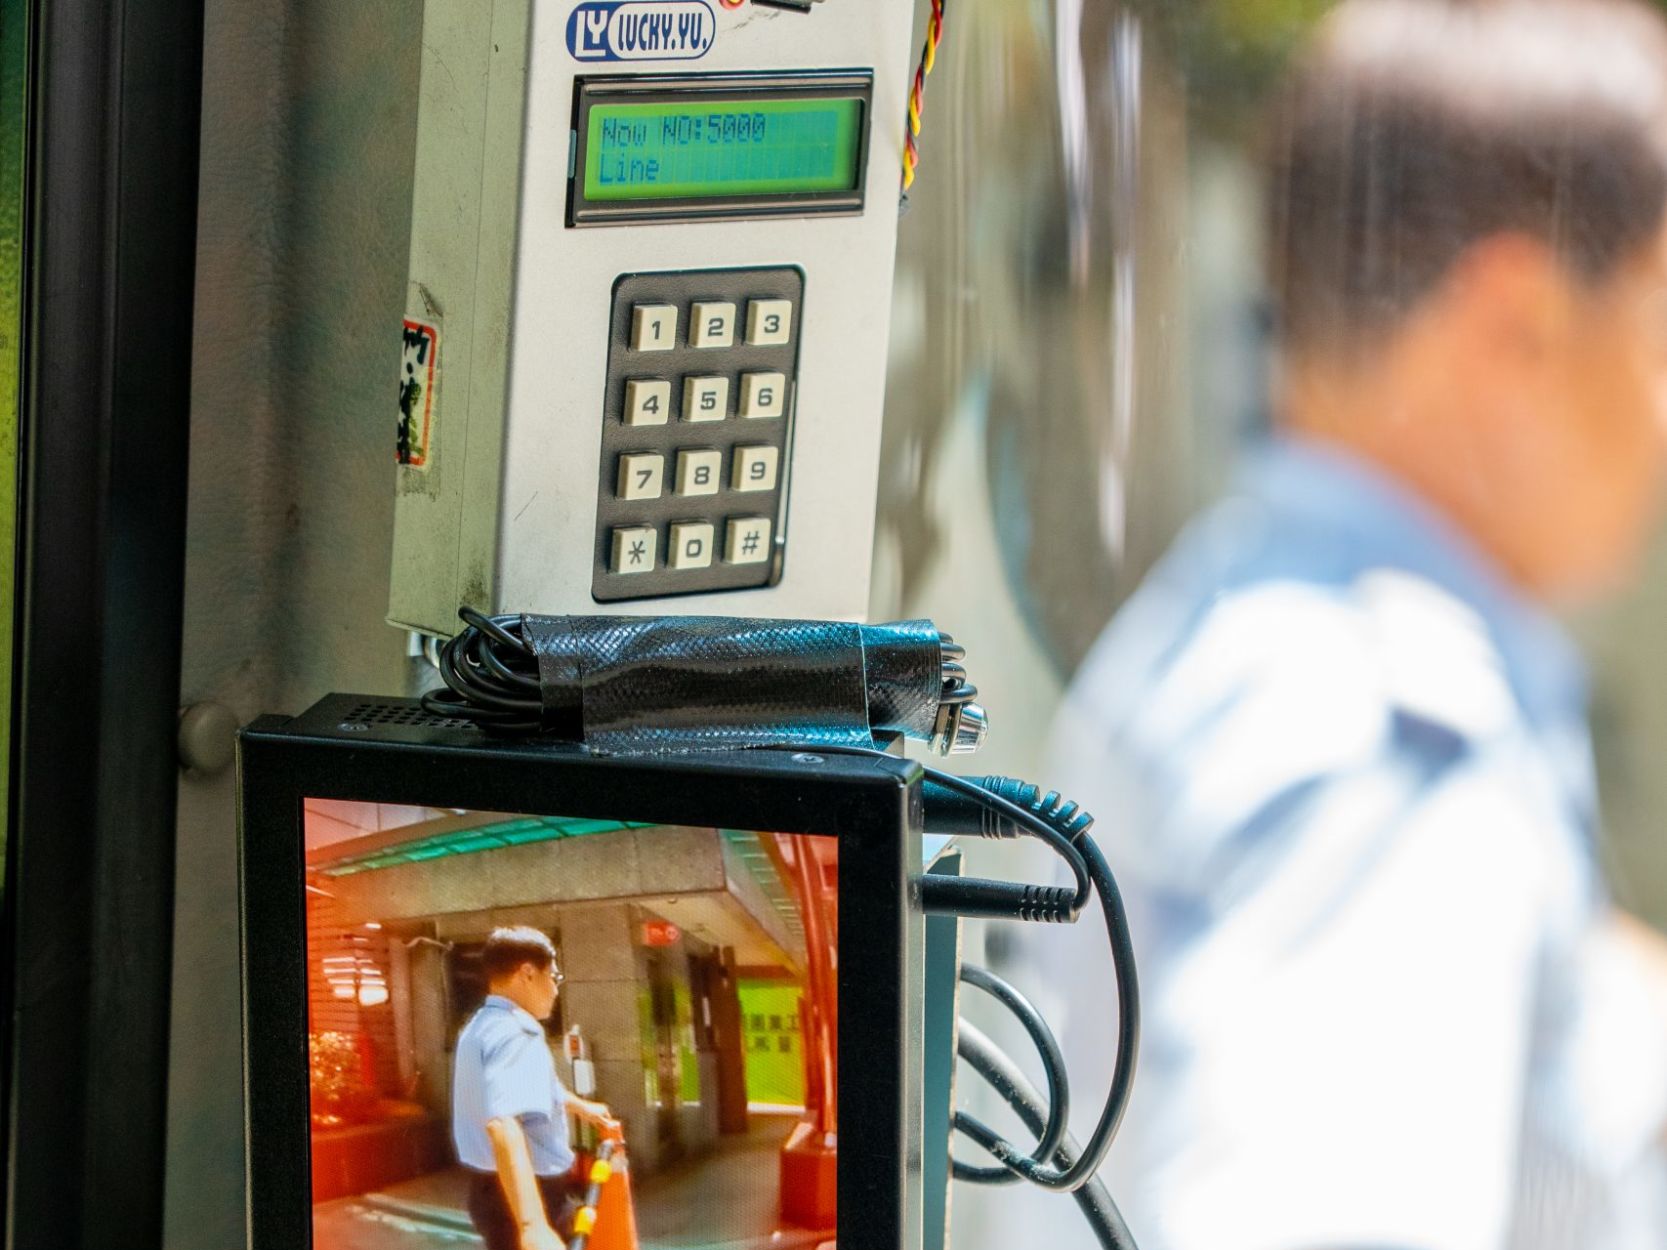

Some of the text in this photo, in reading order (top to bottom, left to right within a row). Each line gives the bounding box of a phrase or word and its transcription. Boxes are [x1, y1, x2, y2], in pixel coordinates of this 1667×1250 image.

[575, 10, 608, 57] LY
[602, 112, 766, 148] Now NO:5000
[600, 153, 660, 183] Line
[651, 314, 780, 340] 1 2 3
[642, 388, 773, 414] 4 5 6
[636, 461, 767, 488] 7 8 9
[686, 539, 702, 558] 0
